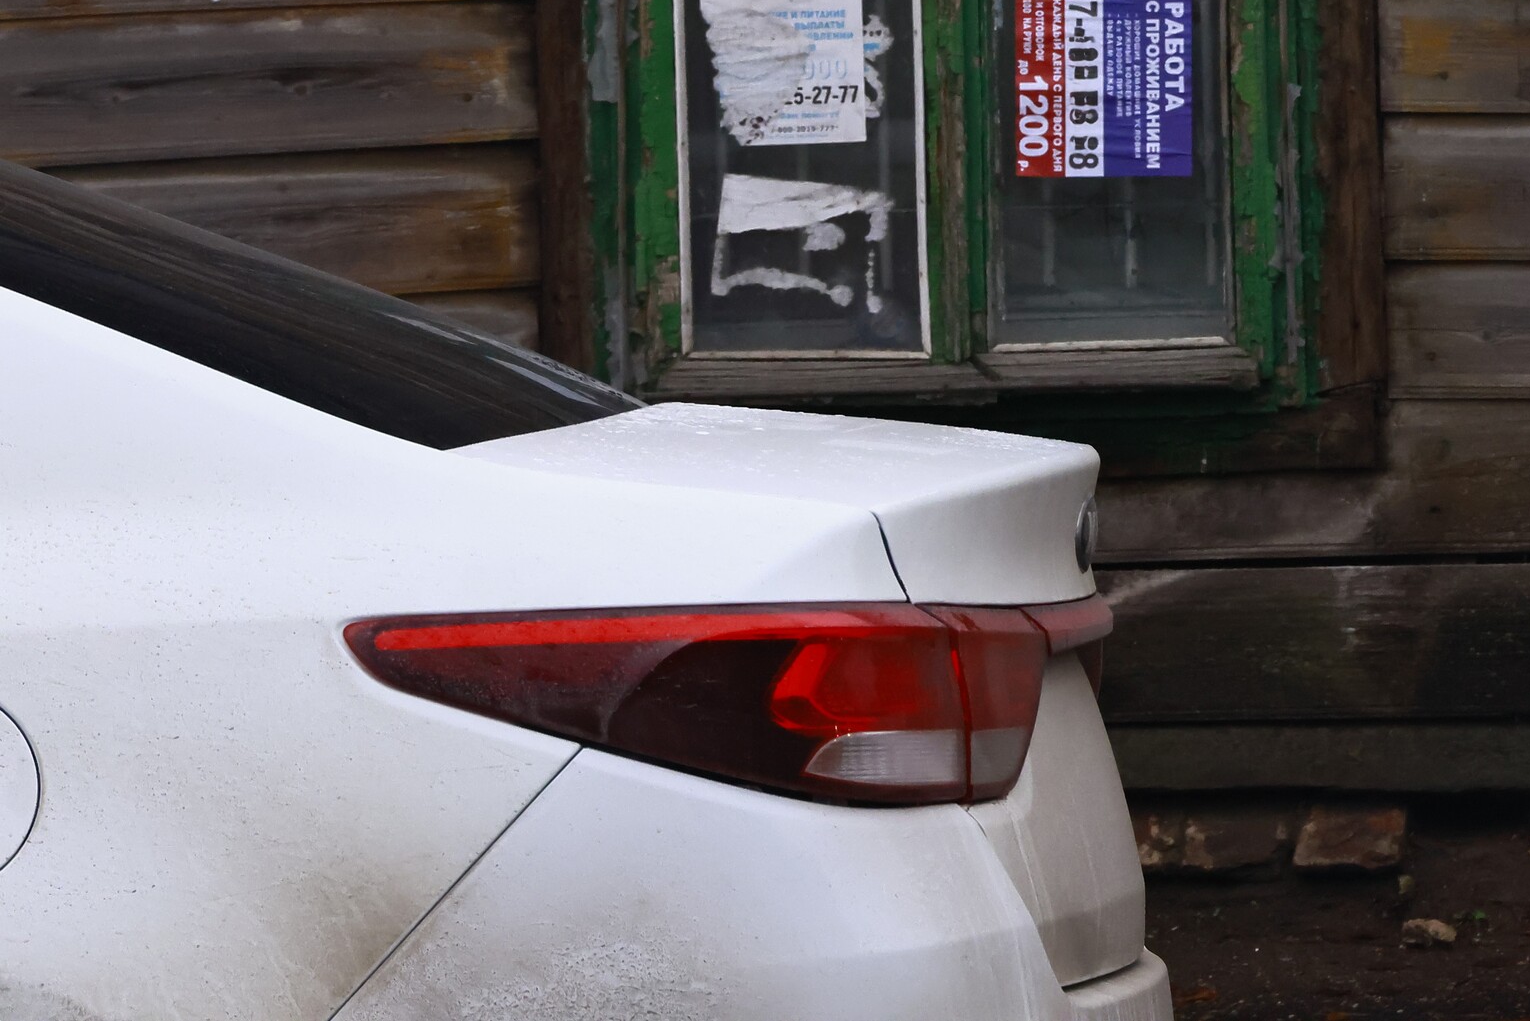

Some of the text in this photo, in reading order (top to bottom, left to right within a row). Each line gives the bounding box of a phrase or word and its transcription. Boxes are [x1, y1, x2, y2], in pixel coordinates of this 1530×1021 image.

[800, 10, 846, 18] ПИТАНИЕ
[1024, 18, 1031, 28] НА
[1023, 31, 1032, 53] РУКИ
[1035, 10, 1044, 61] ОТГОВОРОК
[1052, 53, 1061, 81] ДЕНЬ
[1165, 2, 1184, 111] РАБОТА
[1053, 84, 1062, 92] С
[1146, 1, 1160, 168] С ПРОЖИВАНИЕМ
[1019, 76, 1048, 156] 1200
[1053, 95, 1062, 145] ПЕРВОГО
[1053, 148, 1062, 172] ДНЯ
